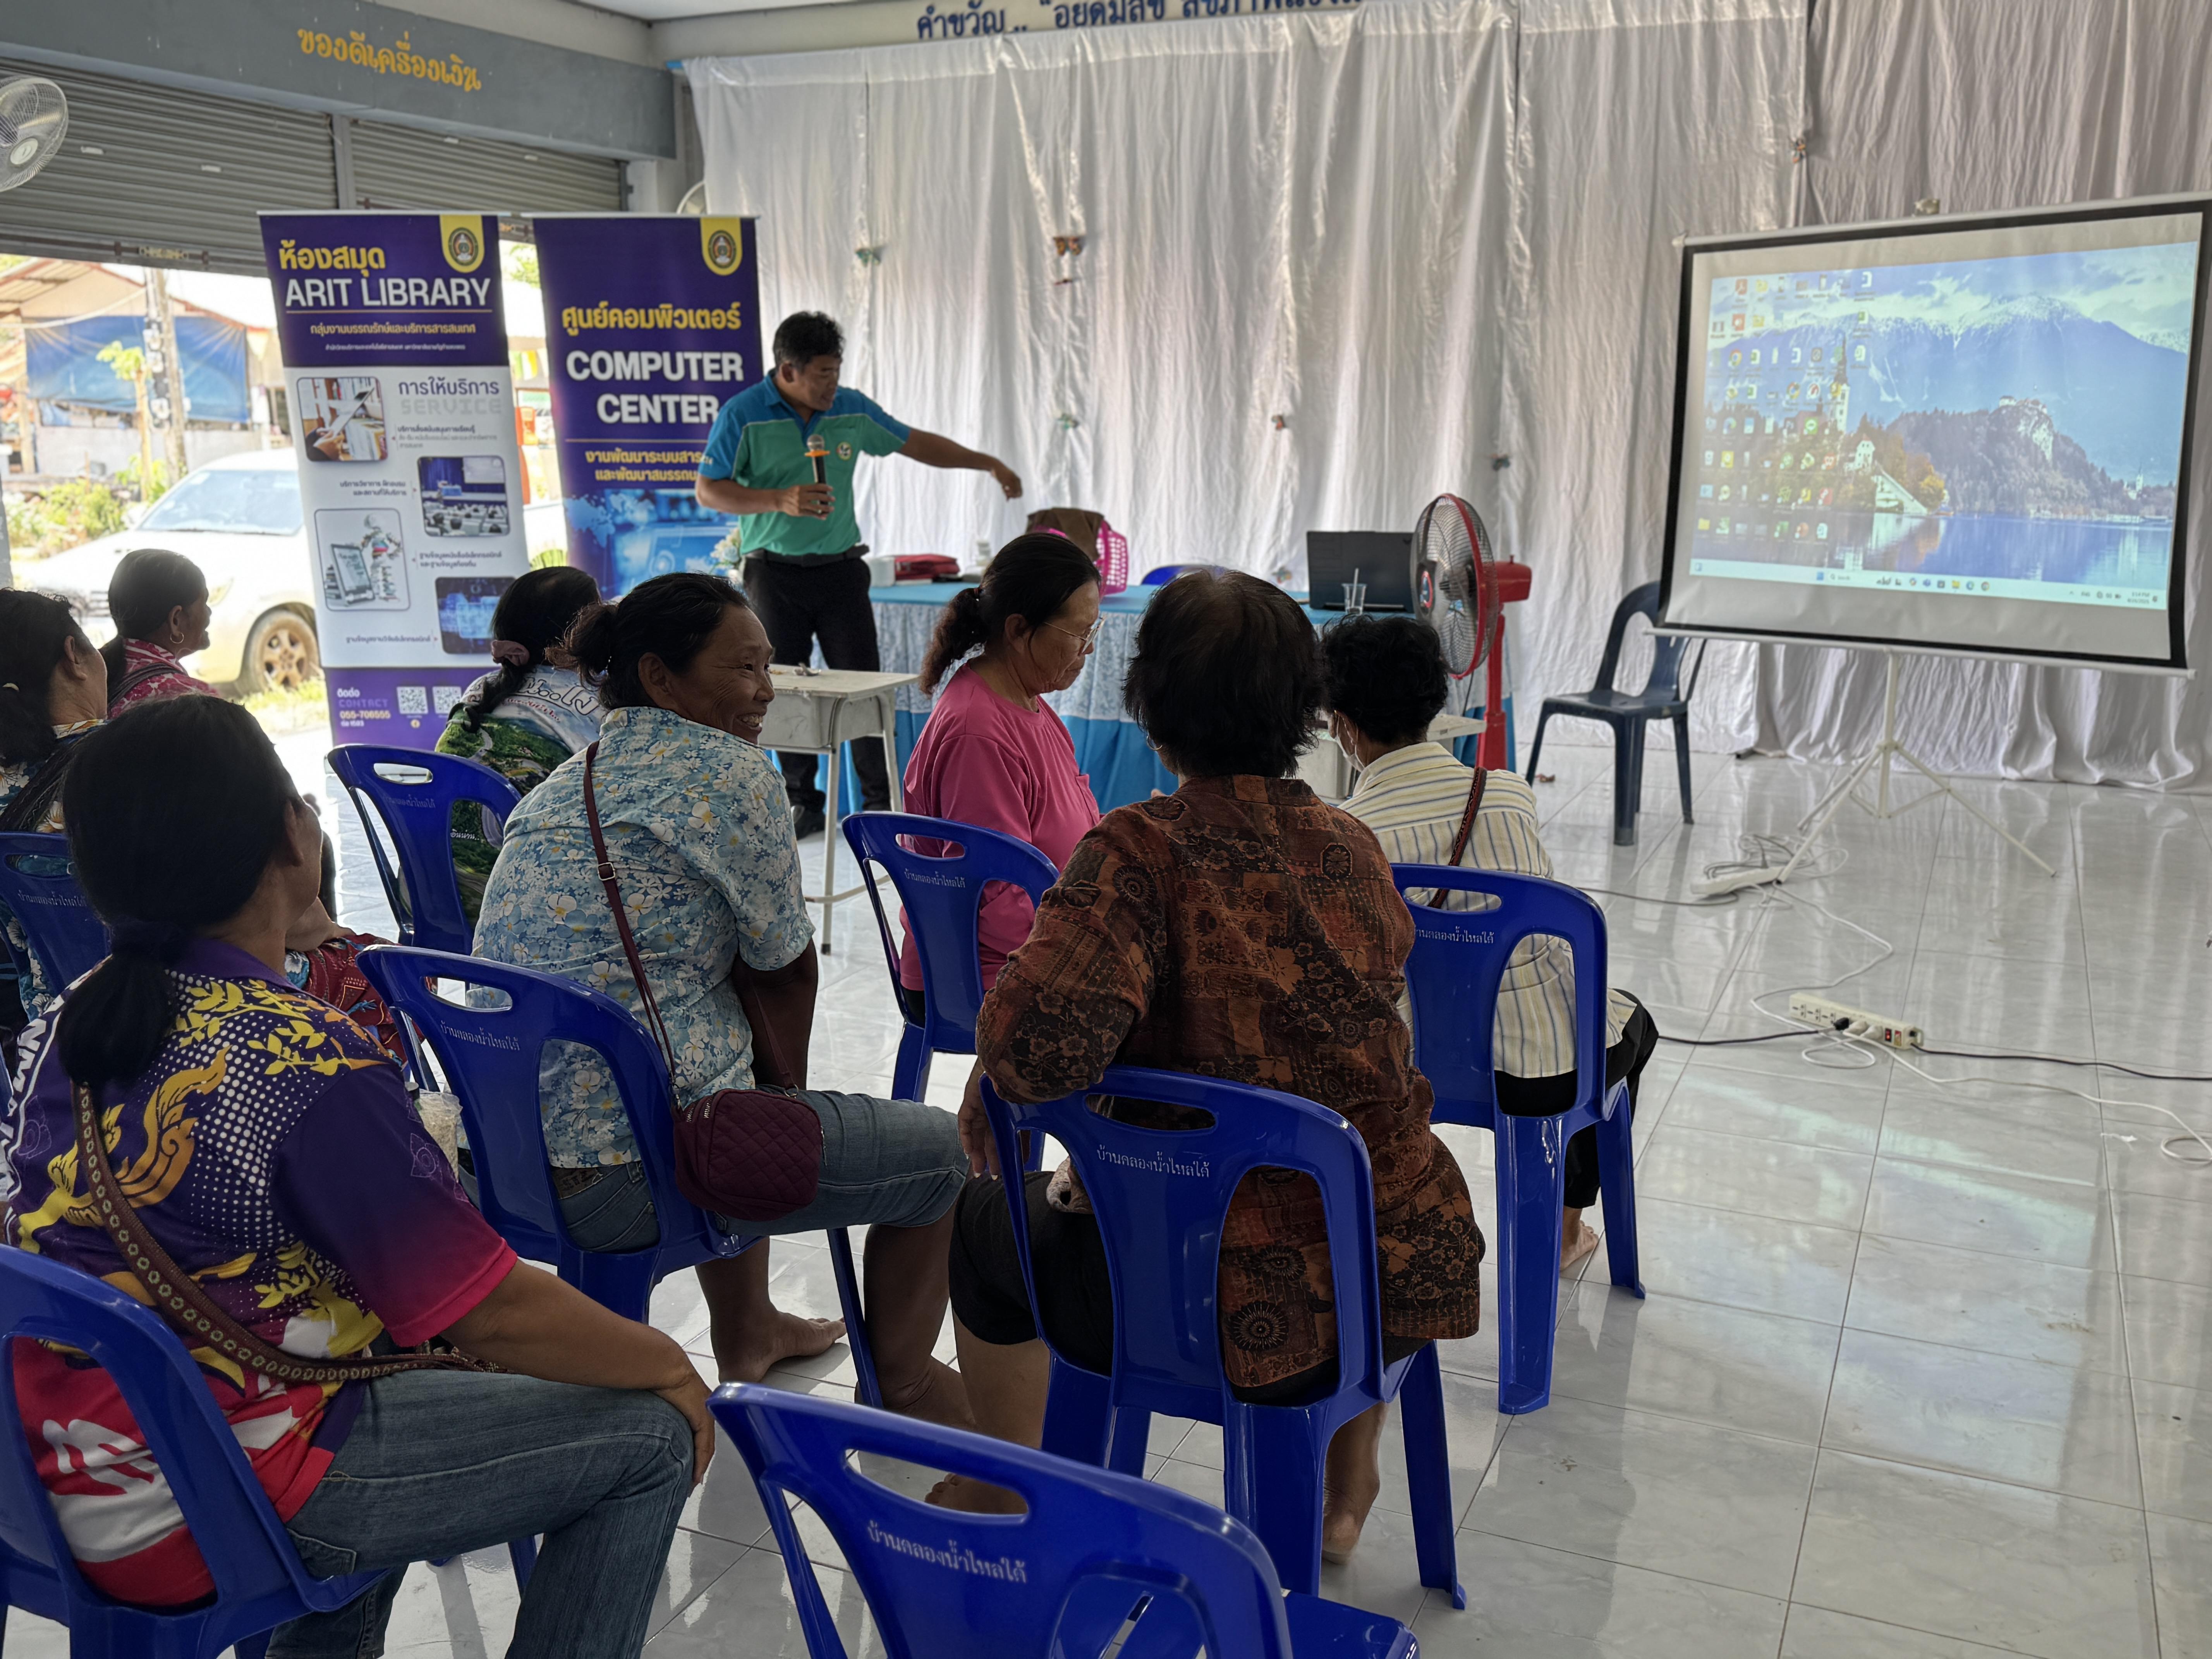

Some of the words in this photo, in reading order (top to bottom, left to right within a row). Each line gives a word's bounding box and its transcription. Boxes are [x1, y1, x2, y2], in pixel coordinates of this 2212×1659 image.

[278, 240, 385, 277] ห้องสมุด
[286, 278, 352, 307] ARIT
[361, 278, 491, 306] LIBRARY
[562, 301, 742, 336] ศูนย์คอมพิวเตอร์
[566, 350, 744, 381] COMPUTER
[398, 376, 500, 395] การให้บริการ
[401, 398, 501, 415] SERVICE
[597, 393, 720, 423] CENTER
[585, 447, 702, 463] งานพัฒนาระบบสาร
[595, 466, 698, 481] และพัฒนาสมรรถน
[339, 699, 388, 708] CONTACT
[1416, 926, 1494, 944] านคลองน้ำไหลใต้
[1097, 1144, 1209, 1178] บ้านคลองน้ำไหลใต้
[867, 1519, 1027, 1583] บ้านคลองน้ำไหลใต้
